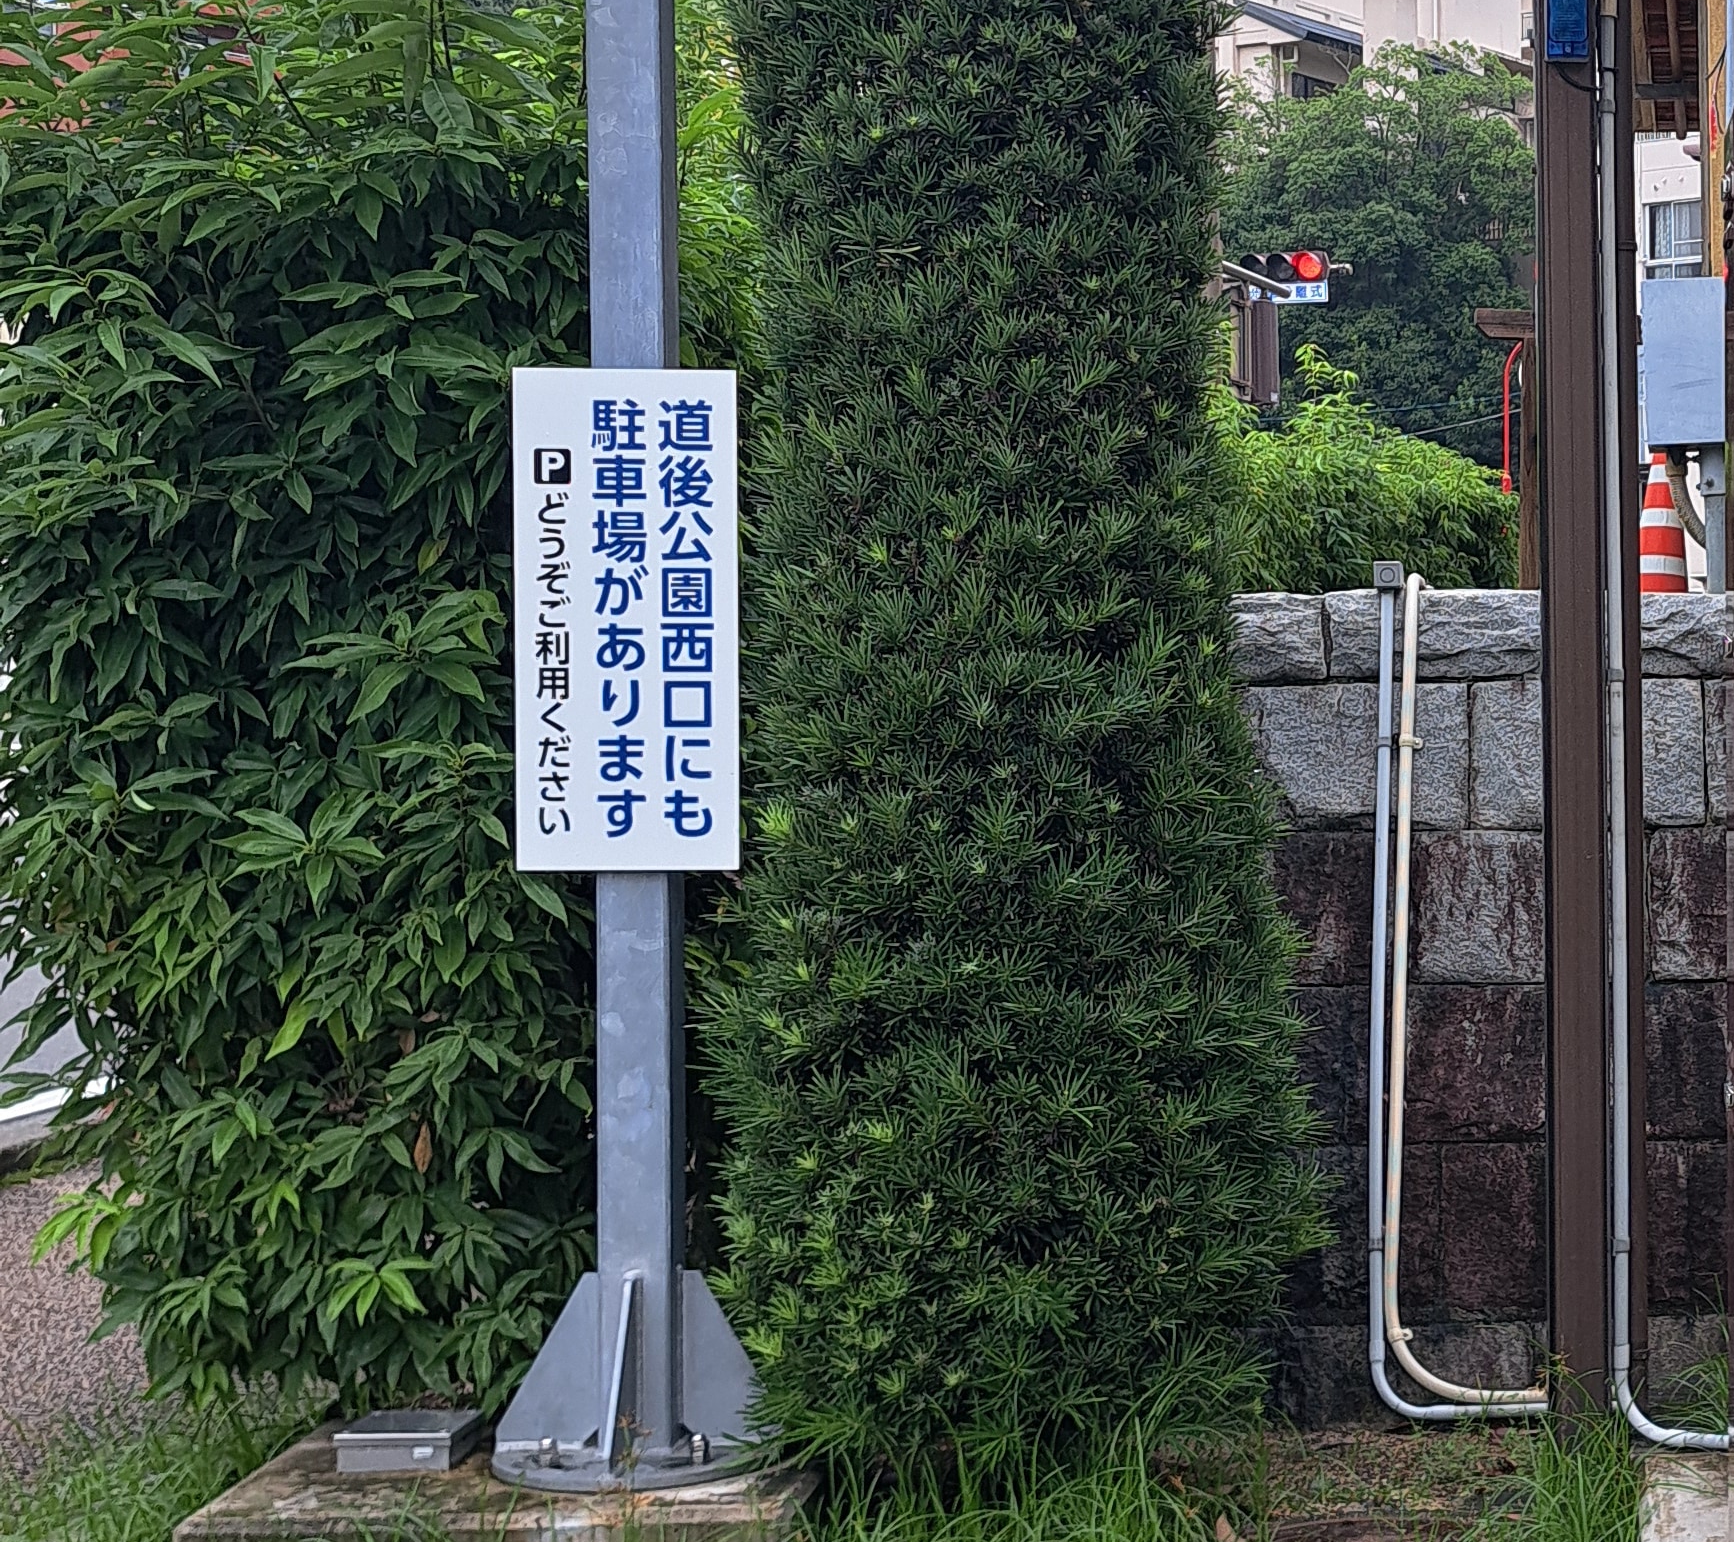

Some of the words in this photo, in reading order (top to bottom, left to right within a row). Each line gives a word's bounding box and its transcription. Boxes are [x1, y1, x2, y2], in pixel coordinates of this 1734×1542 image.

[535, 493, 571, 835] どうぞご利用ください
[591, 399, 646, 838] 駐車場があります
[658, 400, 714, 837] 道後公園西口にも
